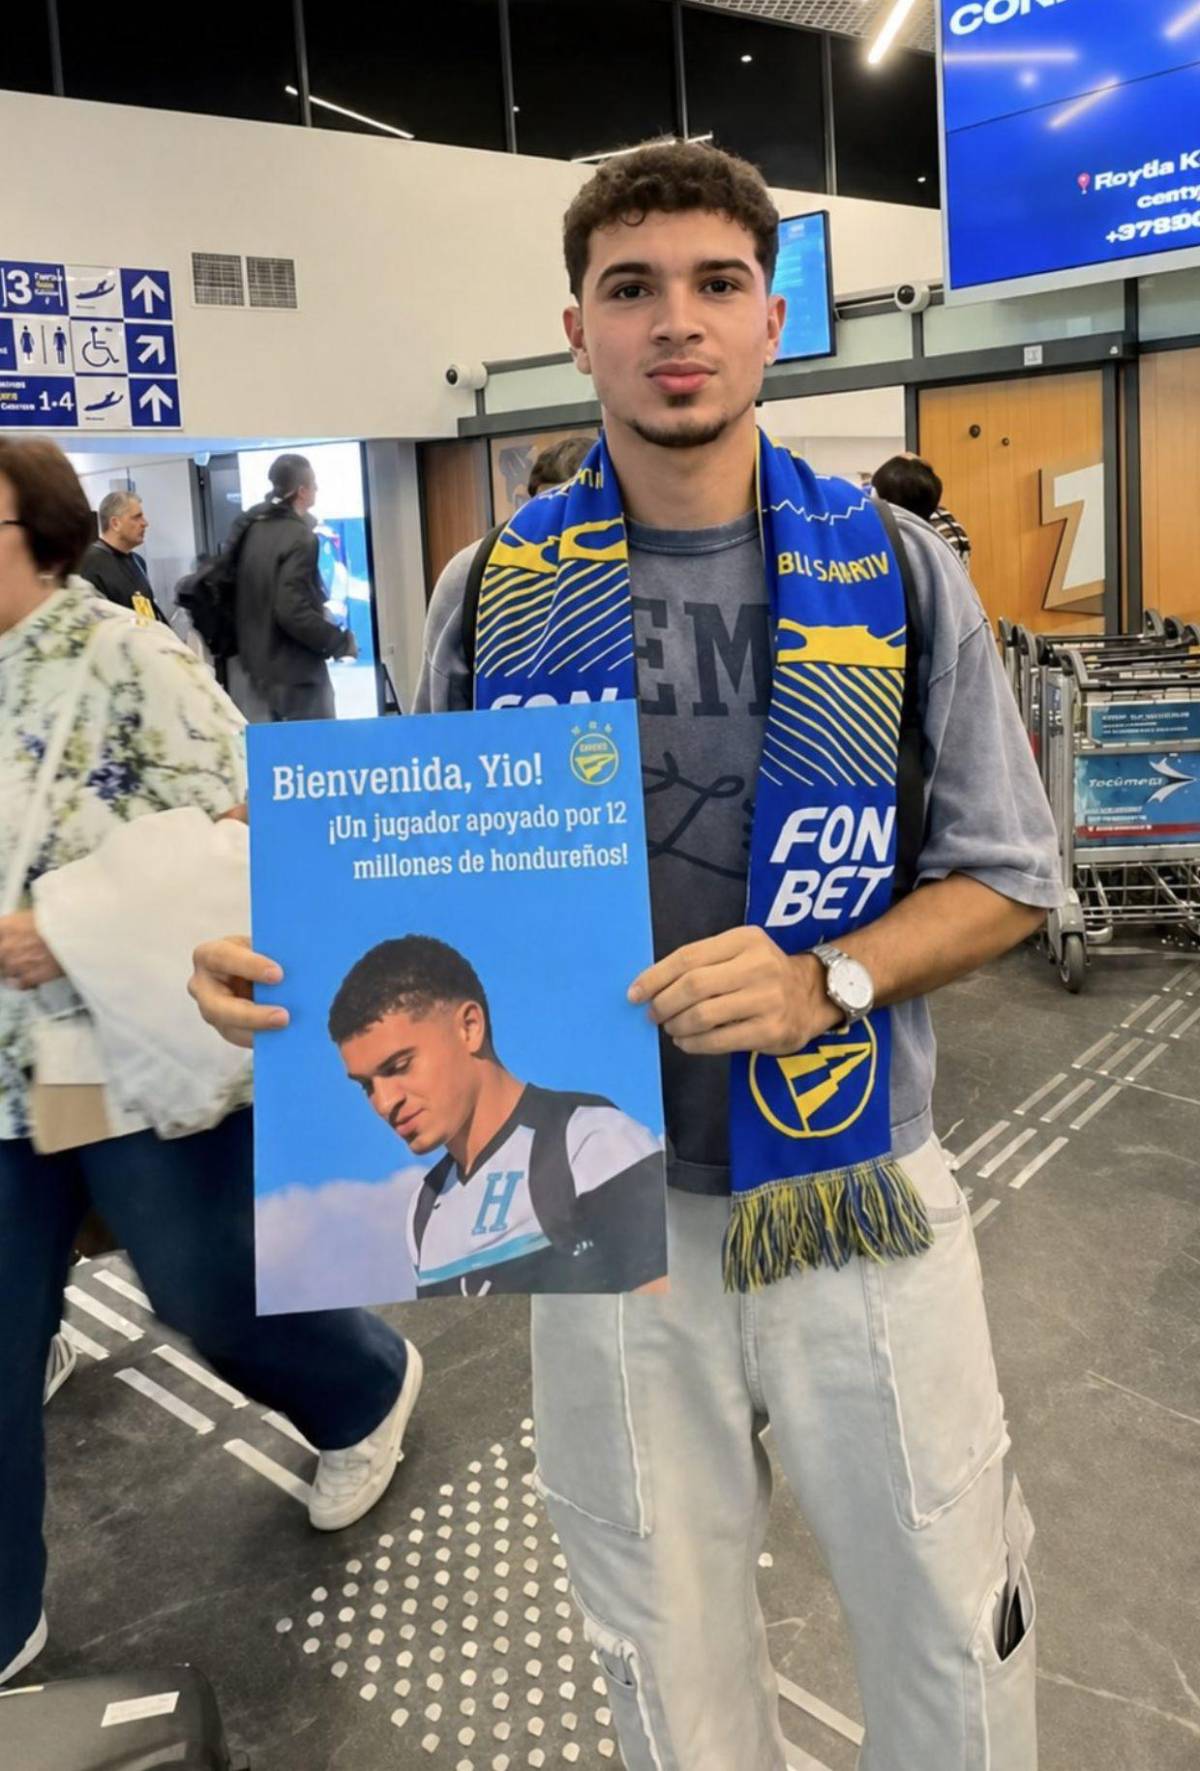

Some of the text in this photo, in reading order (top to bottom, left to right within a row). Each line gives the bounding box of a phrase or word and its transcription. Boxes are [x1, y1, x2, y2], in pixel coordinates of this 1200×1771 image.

[7, 269, 33, 305] 3
[272, 751, 543, 801] Bienvenida, Yio!
[328, 801, 628, 846] ¡Un jugador apoyado por 12
[769, 804, 897, 864] FON
[353, 843, 629, 880] millones de hondureños!
[764, 864, 895, 927] BET
[472, 1170, 525, 1236] H
